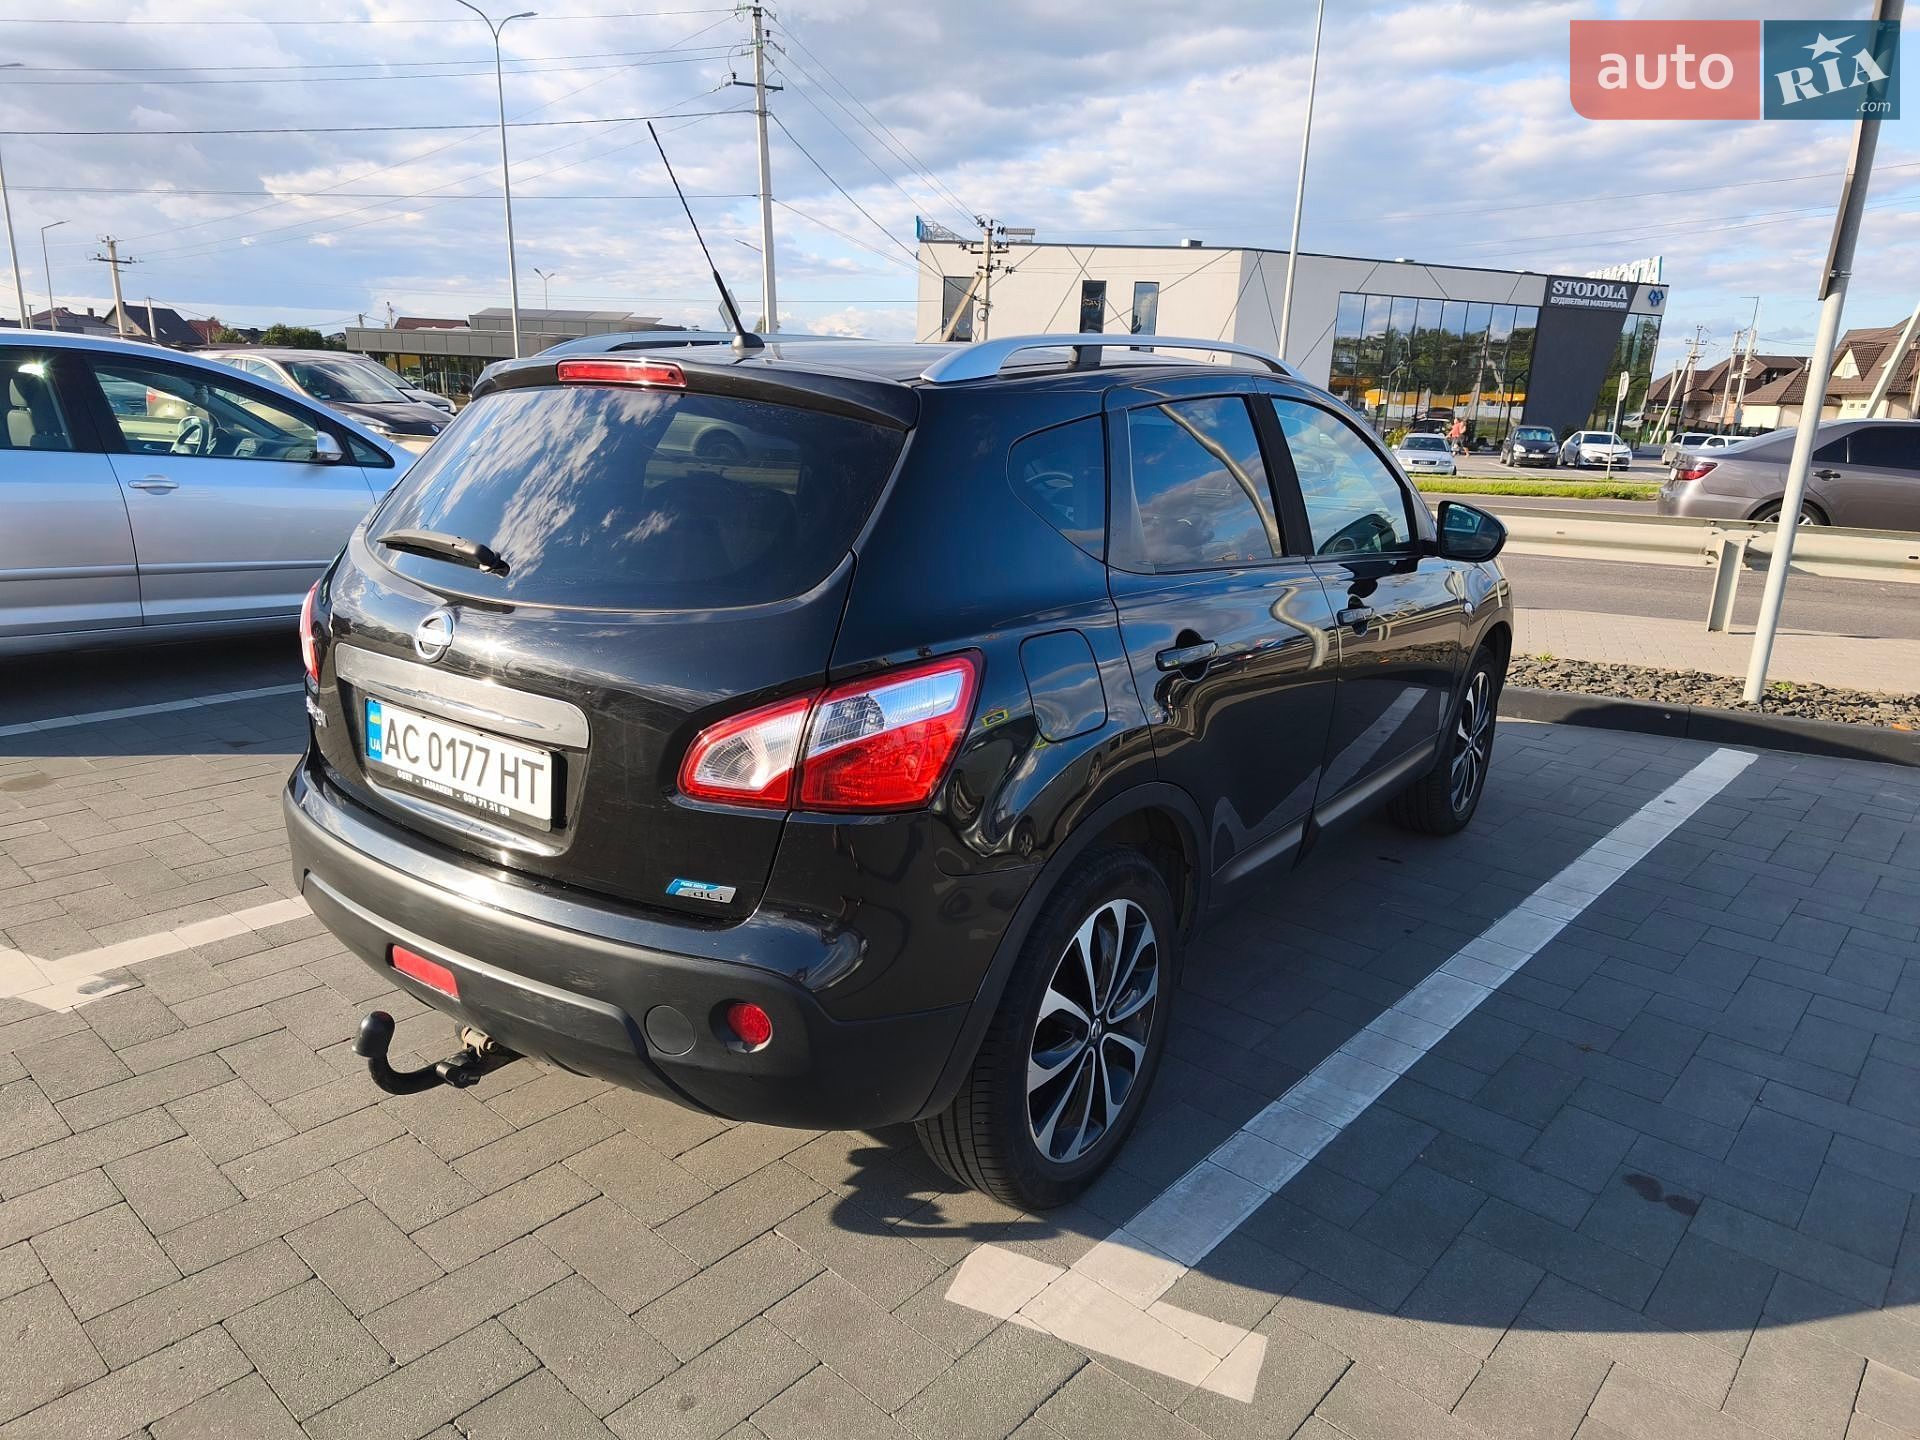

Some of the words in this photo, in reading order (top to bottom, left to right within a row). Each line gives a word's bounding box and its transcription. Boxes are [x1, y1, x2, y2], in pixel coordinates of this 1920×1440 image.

[1552, 280, 1628, 299] STODOLA
[370, 737, 382, 752] UA
[384, 718, 420, 764] AC
[428, 731, 491, 788] 0177
[499, 752, 545, 805] HT
